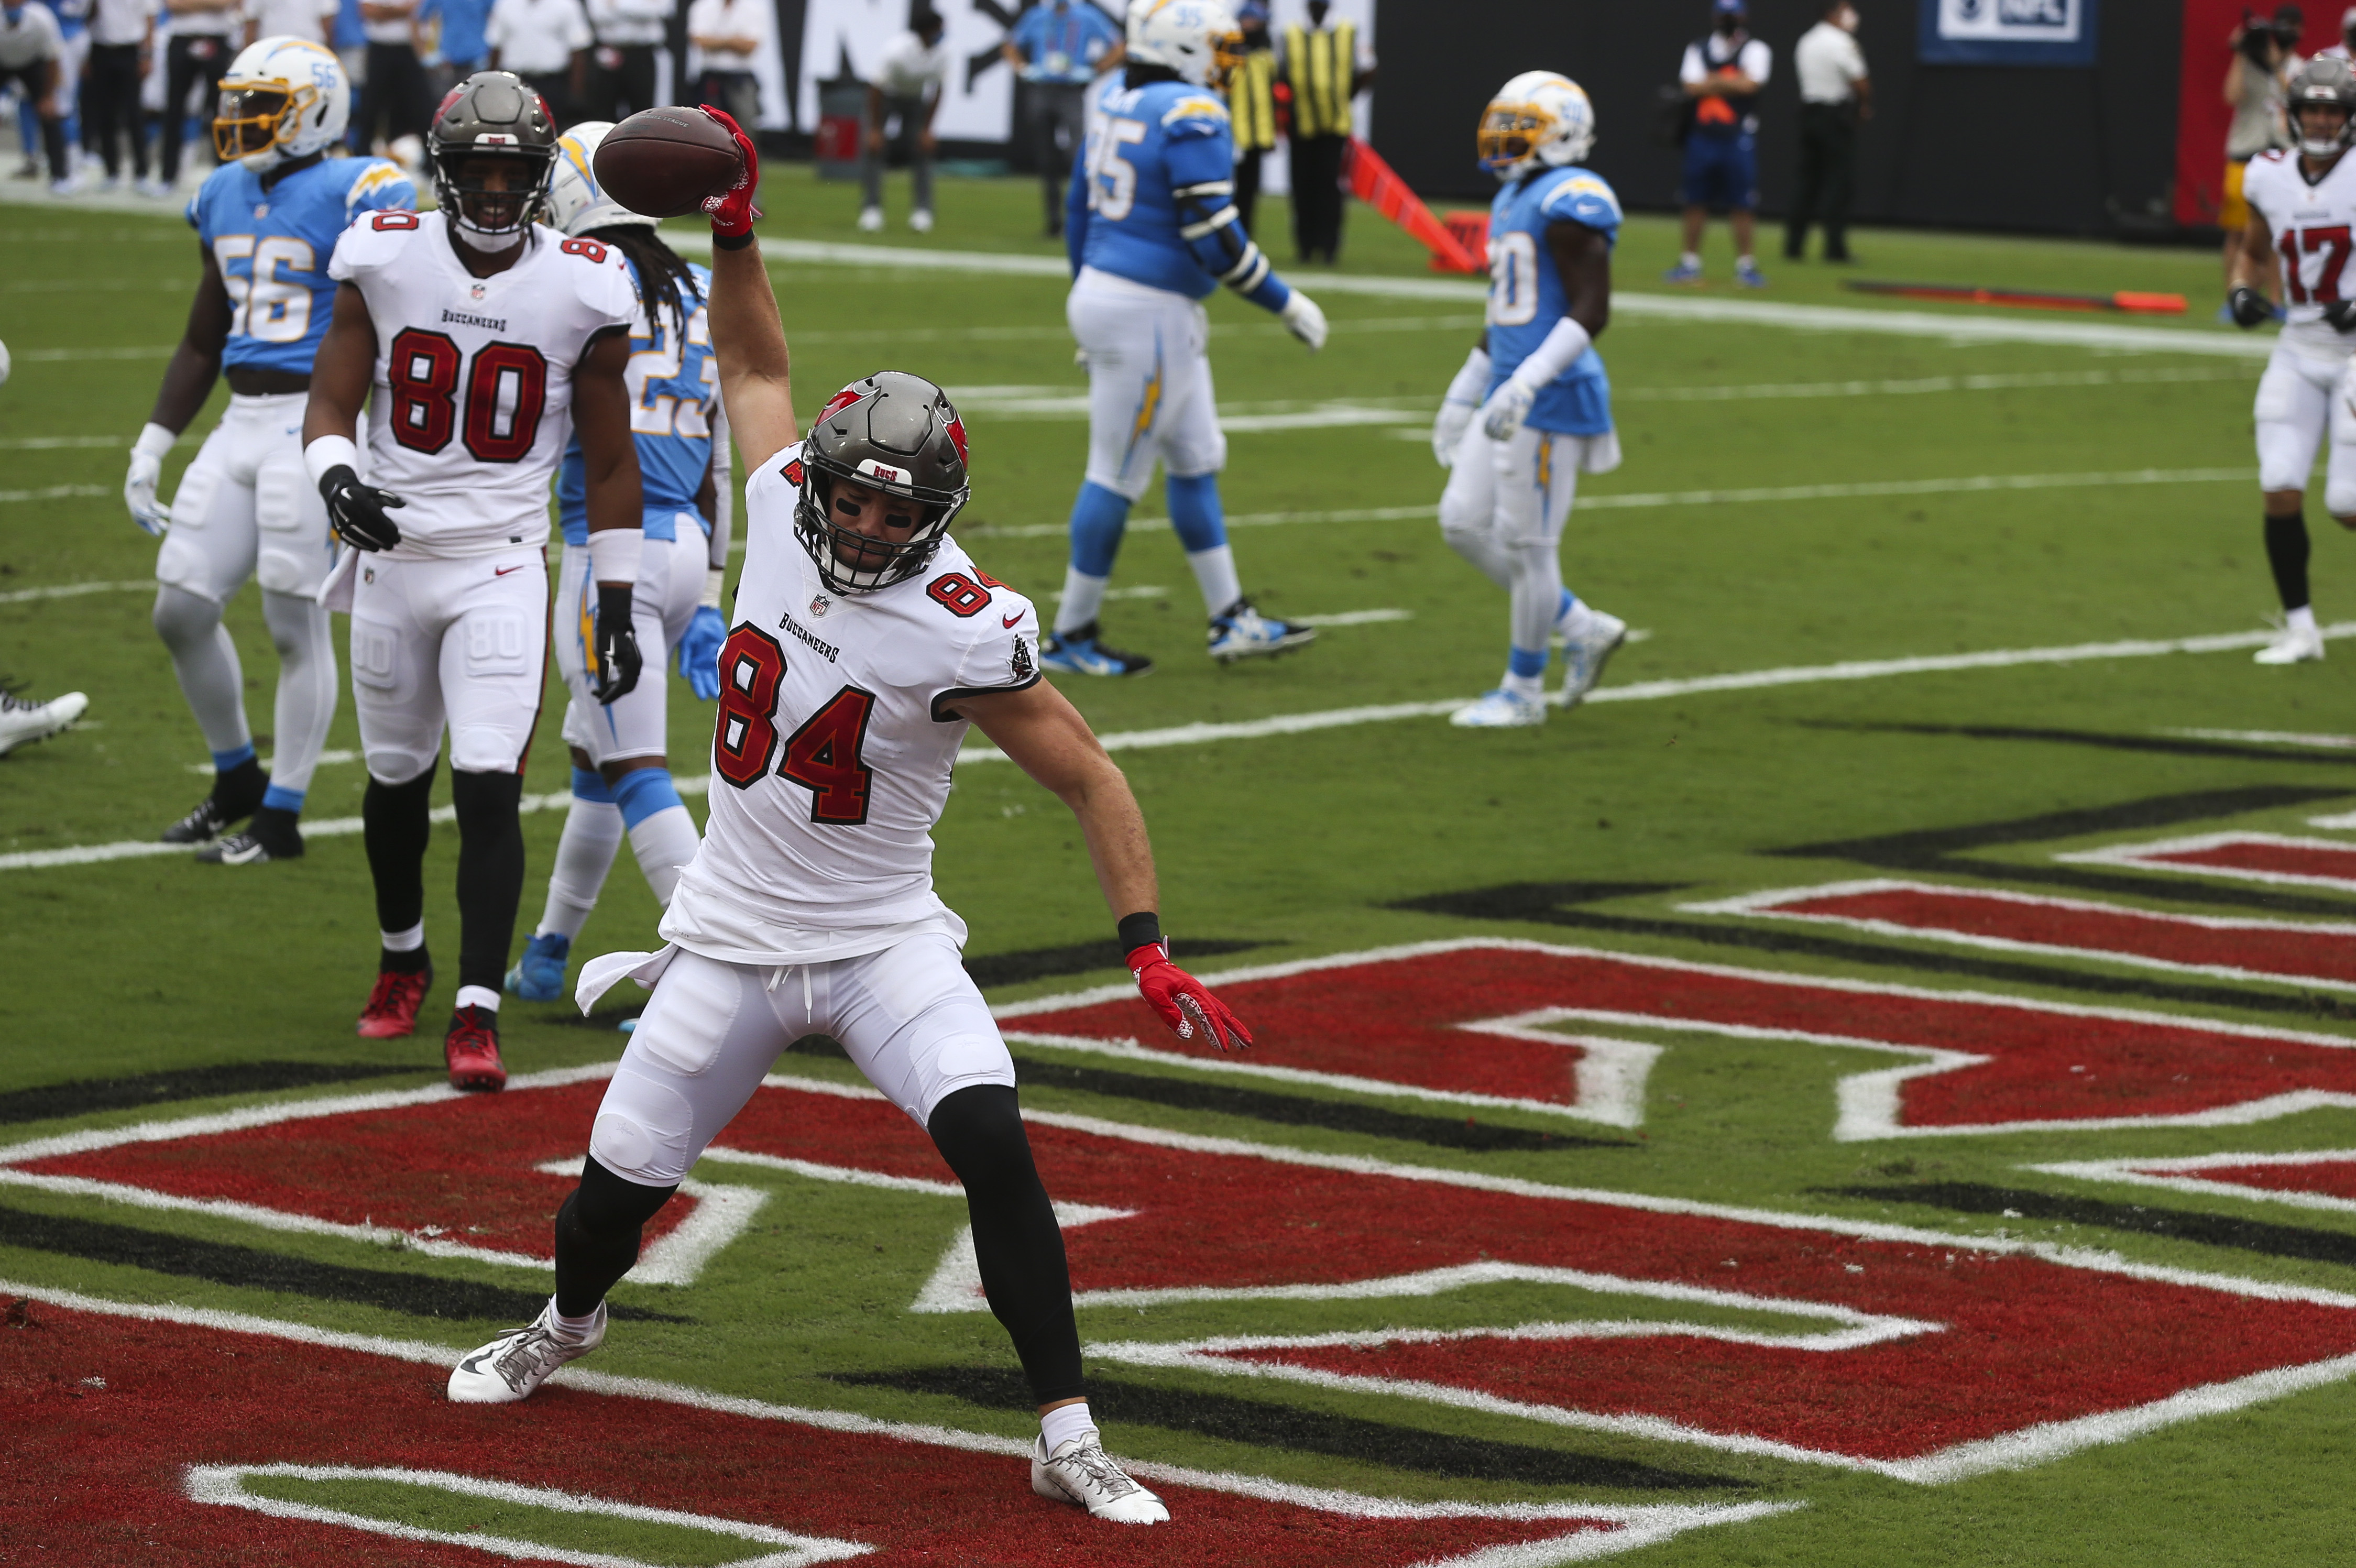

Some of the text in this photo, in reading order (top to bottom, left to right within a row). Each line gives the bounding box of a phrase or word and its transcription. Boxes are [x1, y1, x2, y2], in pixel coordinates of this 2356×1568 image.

[311, 62, 337, 88] 56
[663, 116, 690, 127] LEAGUE
[213, 235, 315, 343] 56
[2280, 225, 2352, 303] 17
[387, 326, 547, 463] 80
[778, 611, 840, 664] BUCCANEERS
[811, 601, 825, 615] NFL
[715, 620, 876, 826] 84
